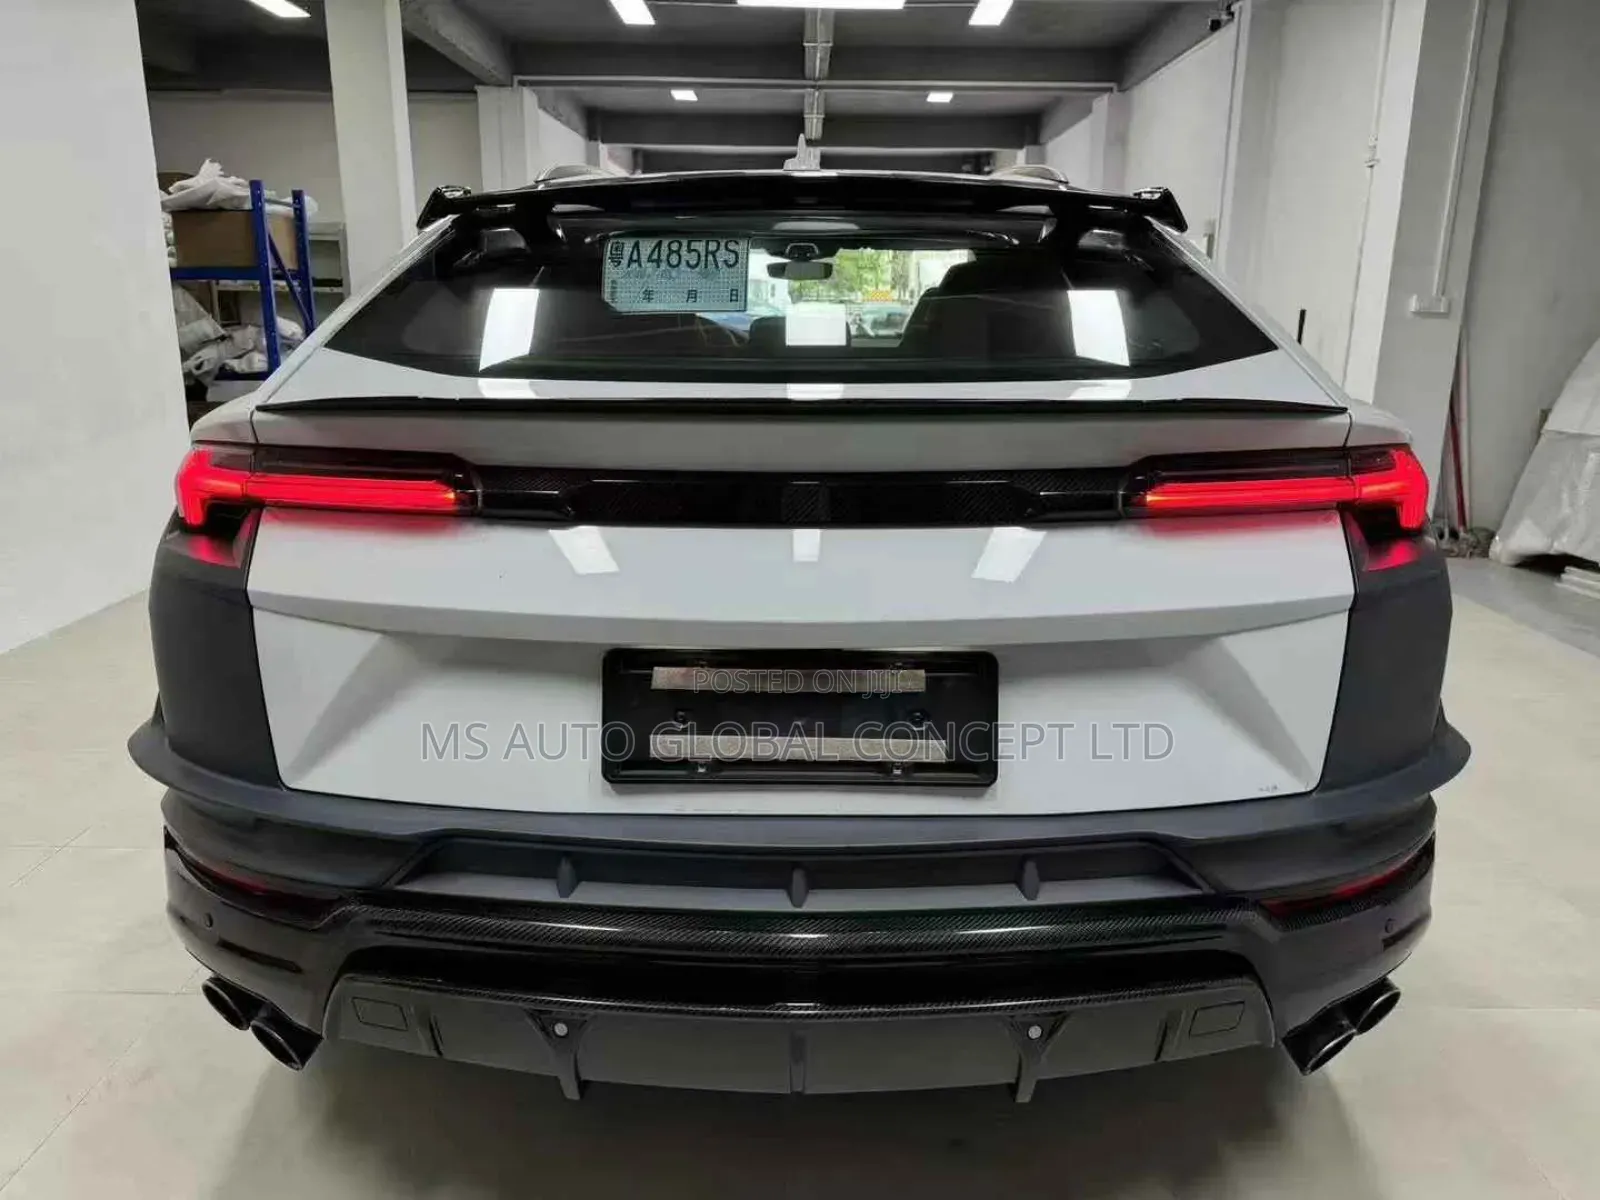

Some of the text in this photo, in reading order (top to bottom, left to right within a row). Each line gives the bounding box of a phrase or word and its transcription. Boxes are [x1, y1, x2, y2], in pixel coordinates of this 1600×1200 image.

[642, 286, 739, 303] 年 月 日
